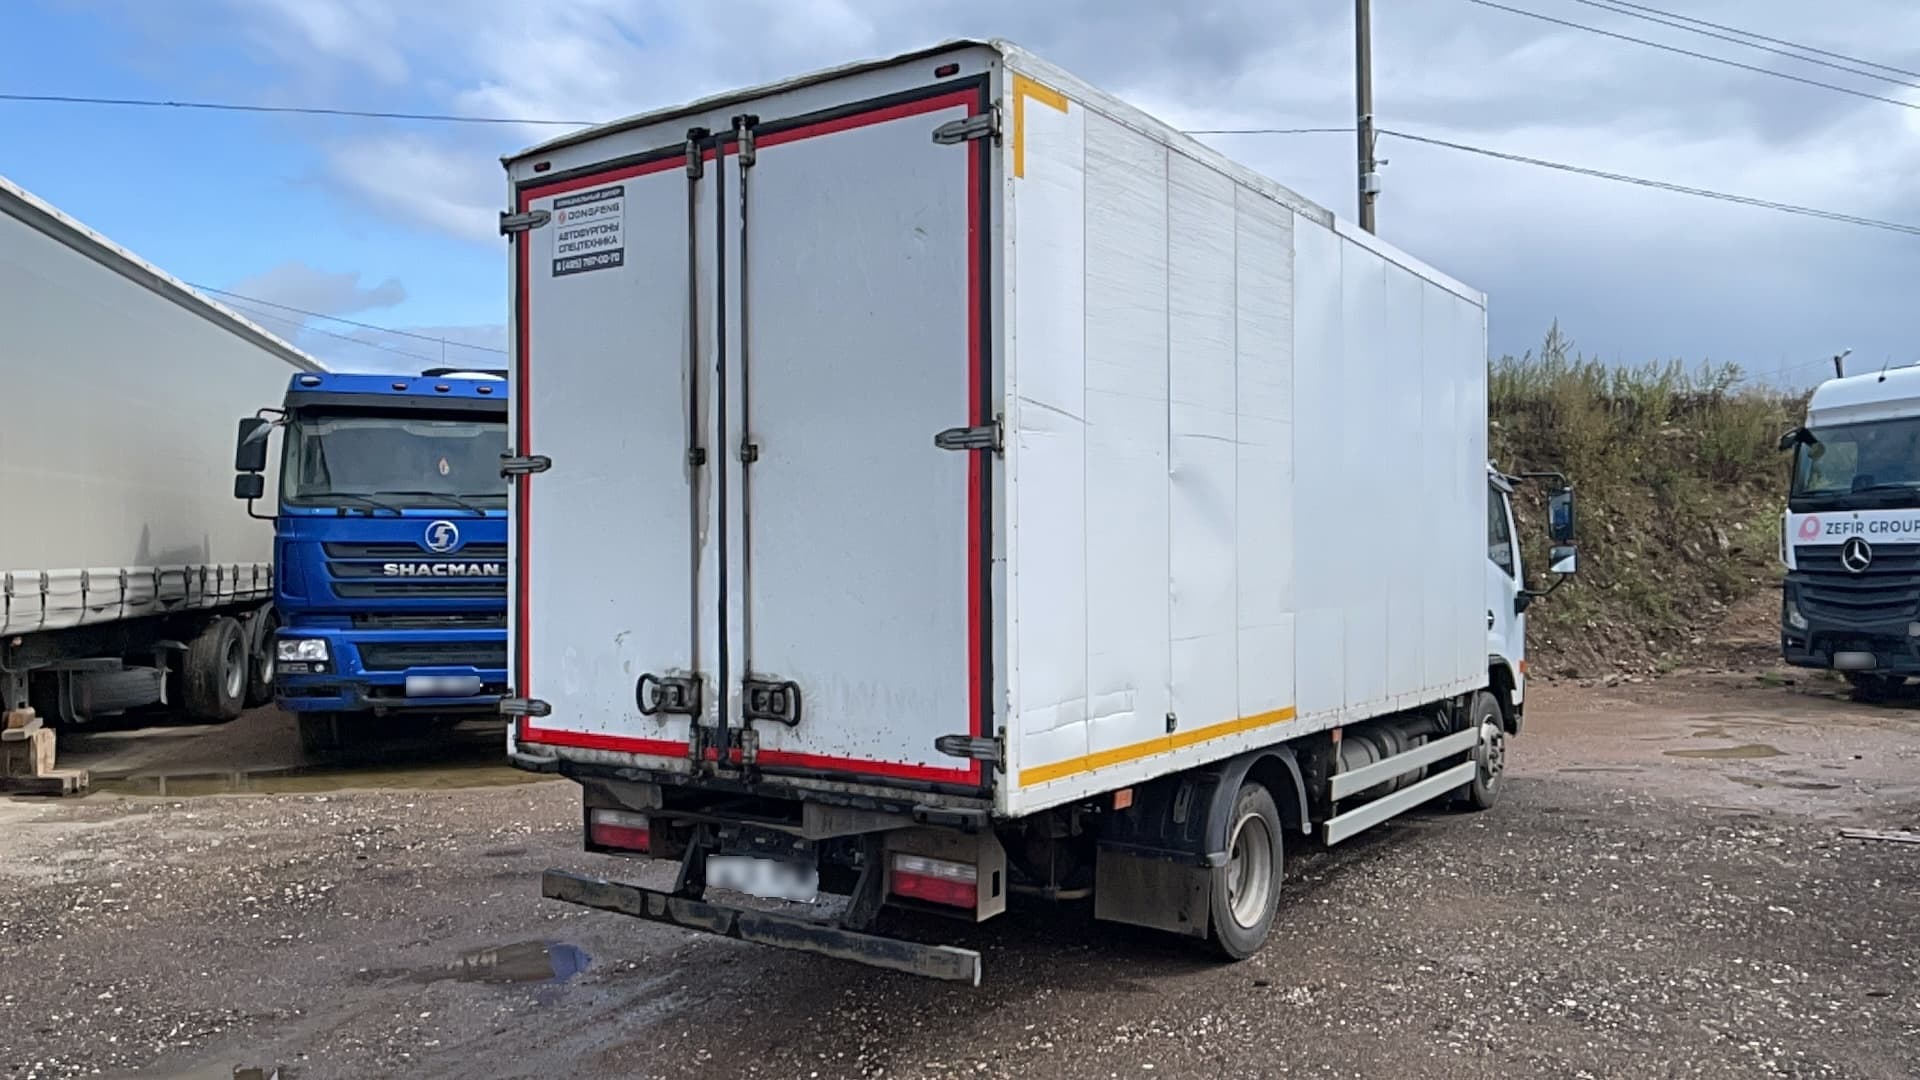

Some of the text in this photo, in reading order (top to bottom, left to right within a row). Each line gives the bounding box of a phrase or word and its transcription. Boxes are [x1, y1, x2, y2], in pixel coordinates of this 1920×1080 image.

[568, 202, 619, 220] DONGFENG
[559, 222, 619, 241] АВТОФУРГОНЫ
[559, 235, 617, 253] СПЕЦТЕХНИКА
[1826, 520, 1920, 535] ZEFIR GROUP
[383, 563, 500, 576] SHACMAN
